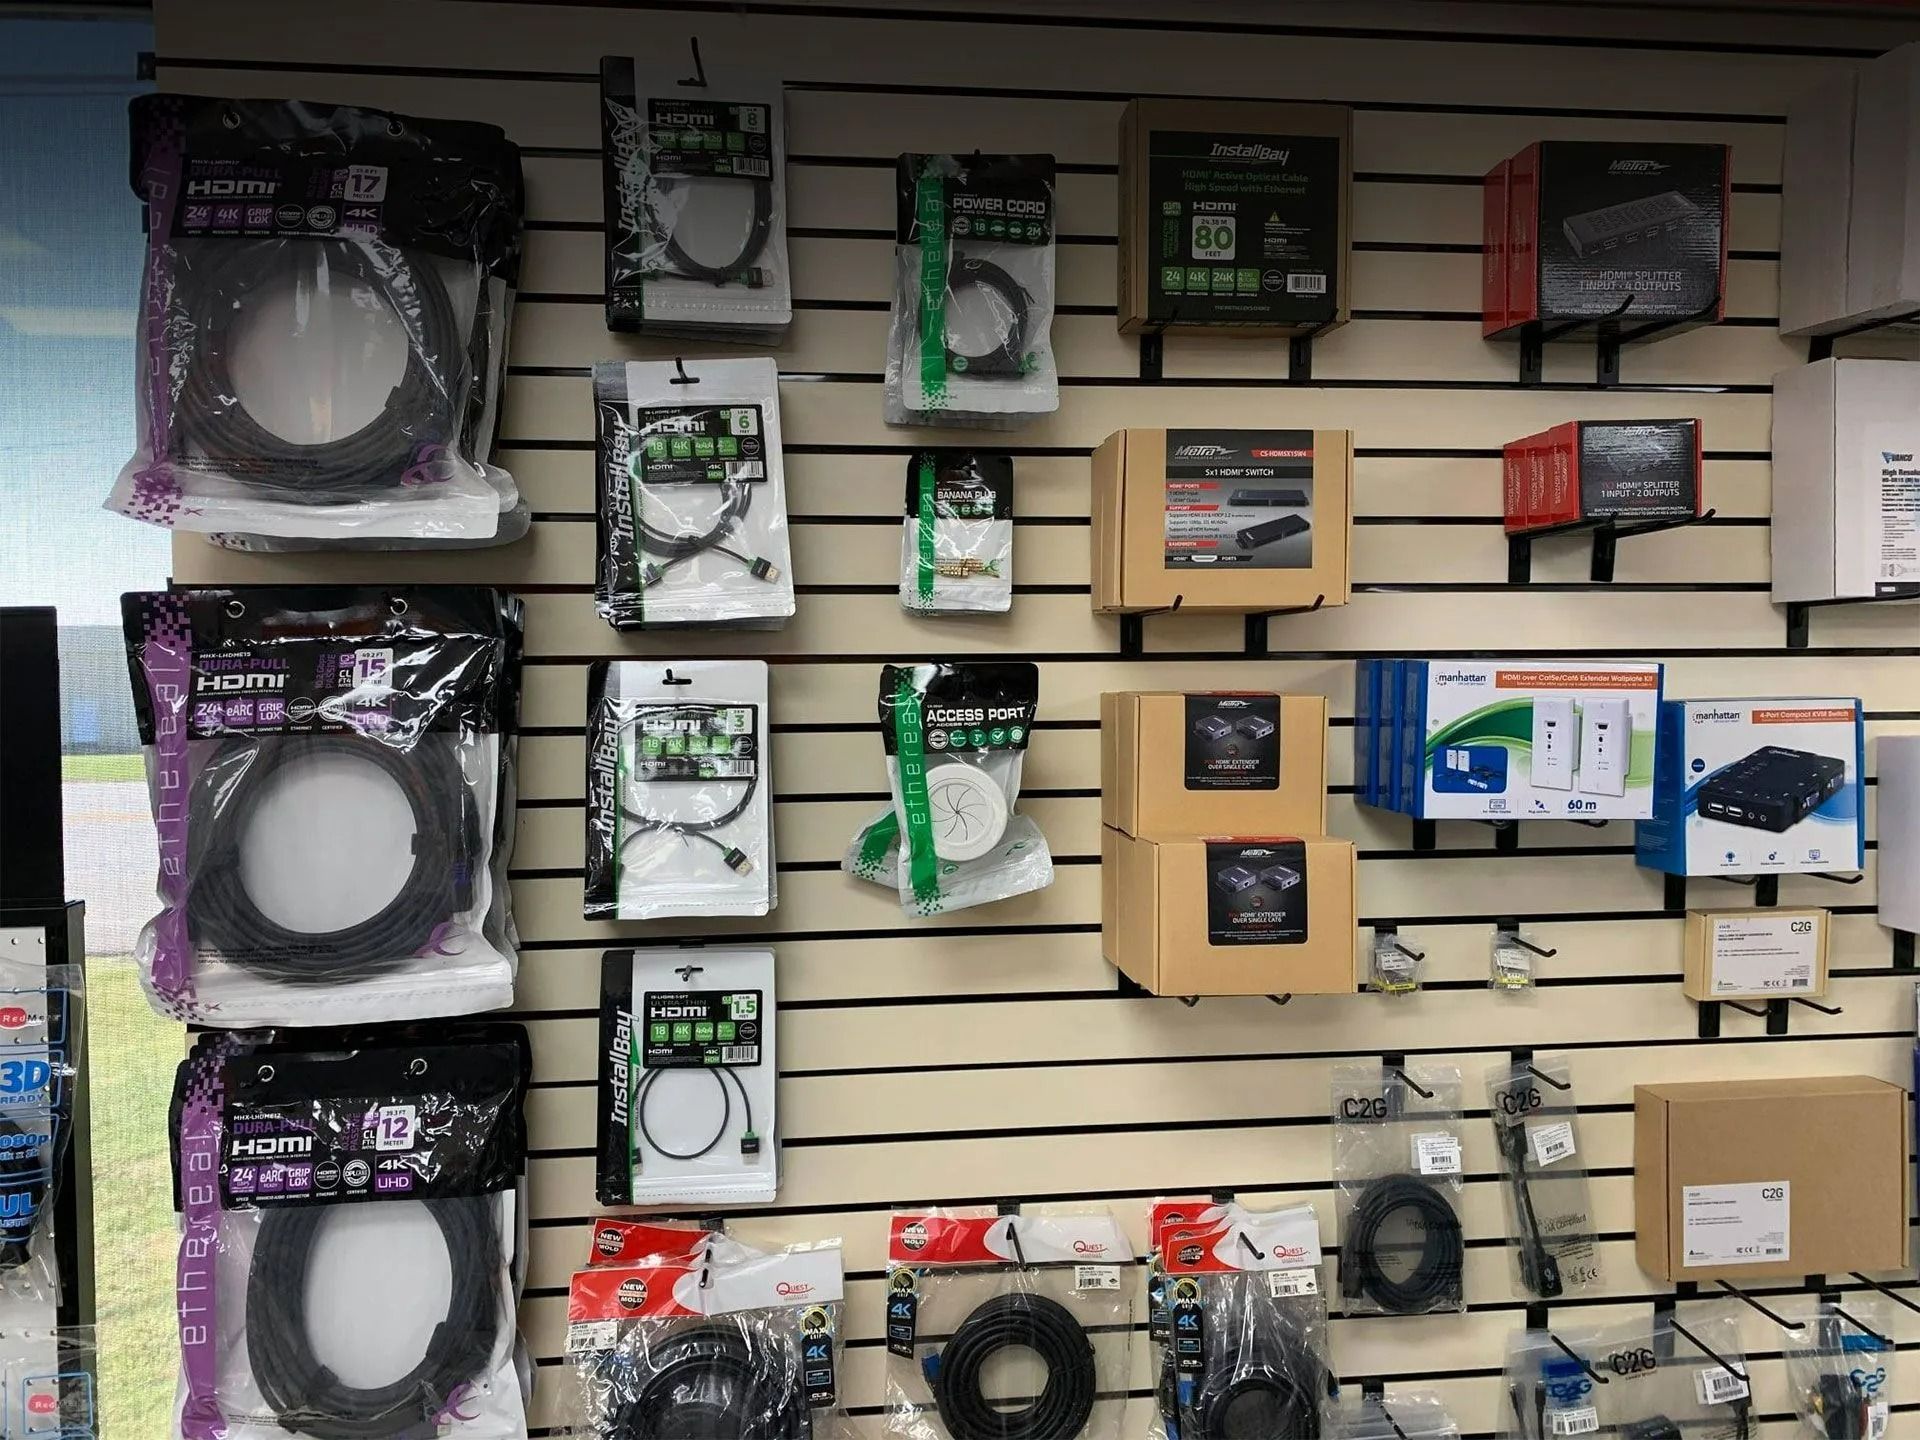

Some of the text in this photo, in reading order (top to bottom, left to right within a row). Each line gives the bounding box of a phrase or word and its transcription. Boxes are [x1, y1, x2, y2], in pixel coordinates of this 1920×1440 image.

[655, 112, 714, 126] HDMI
[748, 113, 758, 128] 8
[1210, 143, 1290, 166] InstallBay
[1608, 160, 1652, 171] Metra
[1182, 170, 1309, 182] HDMI Active Optical Cable
[187, 180, 276, 195] HDMI
[351, 174, 382, 194] 17
[1184, 182, 1306, 194] High Speed with Ethernet
[186, 206, 208, 218] 24
[953, 198, 1046, 214] POWER CORD
[1192, 202, 1237, 211] HDMI
[217, 208, 239, 220] 4K
[346, 208, 377, 218] 4K
[248, 216, 270, 224] LOX
[974, 222, 986, 232] 18
[1026, 226, 1041, 236] 2M
[1194, 225, 1234, 250] 80
[1165, 270, 1180, 282] 24
[1189, 272, 1207, 282] 4K
[1212, 272, 1234, 282] 24K
[1600, 270, 1682, 280] HDMI SPLITTER
[1586, 281, 1682, 291] INPUT 4 OUTPUTS
[738, 416, 750, 430] 6
[652, 442, 663, 451] 18
[674, 442, 688, 450] 4K
[1174, 446, 1222, 456] Metra
[1882, 469, 1898, 478] High
[1643, 480, 1680, 489] SPLITTER
[938, 490, 997, 500] BANANA PLUG
[1643, 488, 1680, 496] OUTPUTS
[200, 658, 290, 671] DURA-PULL
[358, 658, 386, 678] 15
[339, 670, 352, 678] CL
[1438, 670, 1486, 682] manhattan
[1611, 675, 1644, 683] Wallplate
[196, 674, 285, 690] HDMI
[258, 704, 283, 712] GRIP
[356, 696, 388, 708] 4K
[196, 702, 218, 716] 24
[226, 704, 254, 718] eARC
[926, 706, 1026, 722] ACCESS PORT
[1696, 708, 1740, 720] manhattan
[260, 712, 280, 720] LOX
[734, 714, 744, 728] 3
[648, 740, 658, 748] 18
[668, 740, 682, 748] 4K
[903, 700, 926, 826] ethereal
[1568, 800, 1597, 810] 60 m
[1790, 922, 1812, 932] C2G
[650, 1006, 707, 1018] HDMI
[734, 1000, 756, 1014] 1.5
[654, 1026, 666, 1036] 18
[674, 1026, 689, 1035] 4K
[609, 1009, 640, 1127] InstallBay
[0, 1060, 50, 1093] 3D
[1502, 1087, 1542, 1115] C2G
[1342, 1098, 1388, 1118] C2G
[233, 1118, 316, 1134] DURA-PULL
[382, 1116, 409, 1139] 12
[364, 1130, 376, 1138] CL
[232, 1136, 312, 1156] HDMI
[378, 1158, 408, 1170] 4K
[233, 1168, 253, 1182] 24
[260, 1170, 284, 1183] eARC
[288, 1168, 311, 1178] GRIP
[289, 1177, 308, 1187] LOX
[378, 1176, 410, 1188] UHD
[1762, 1188, 1784, 1199] C2G
[0, 1192, 38, 1218] UL
[176, 1133, 214, 1347] ethereal
[600, 1232, 621, 1242] NEW
[776, 1282, 810, 1296] QUEST
[891, 1303, 911, 1316] 4K
[1178, 1314, 1198, 1327] 4K
[806, 1344, 828, 1358] 4K
[1613, 1348, 1656, 1376] C2G
[1850, 1367, 1886, 1392] C2G
